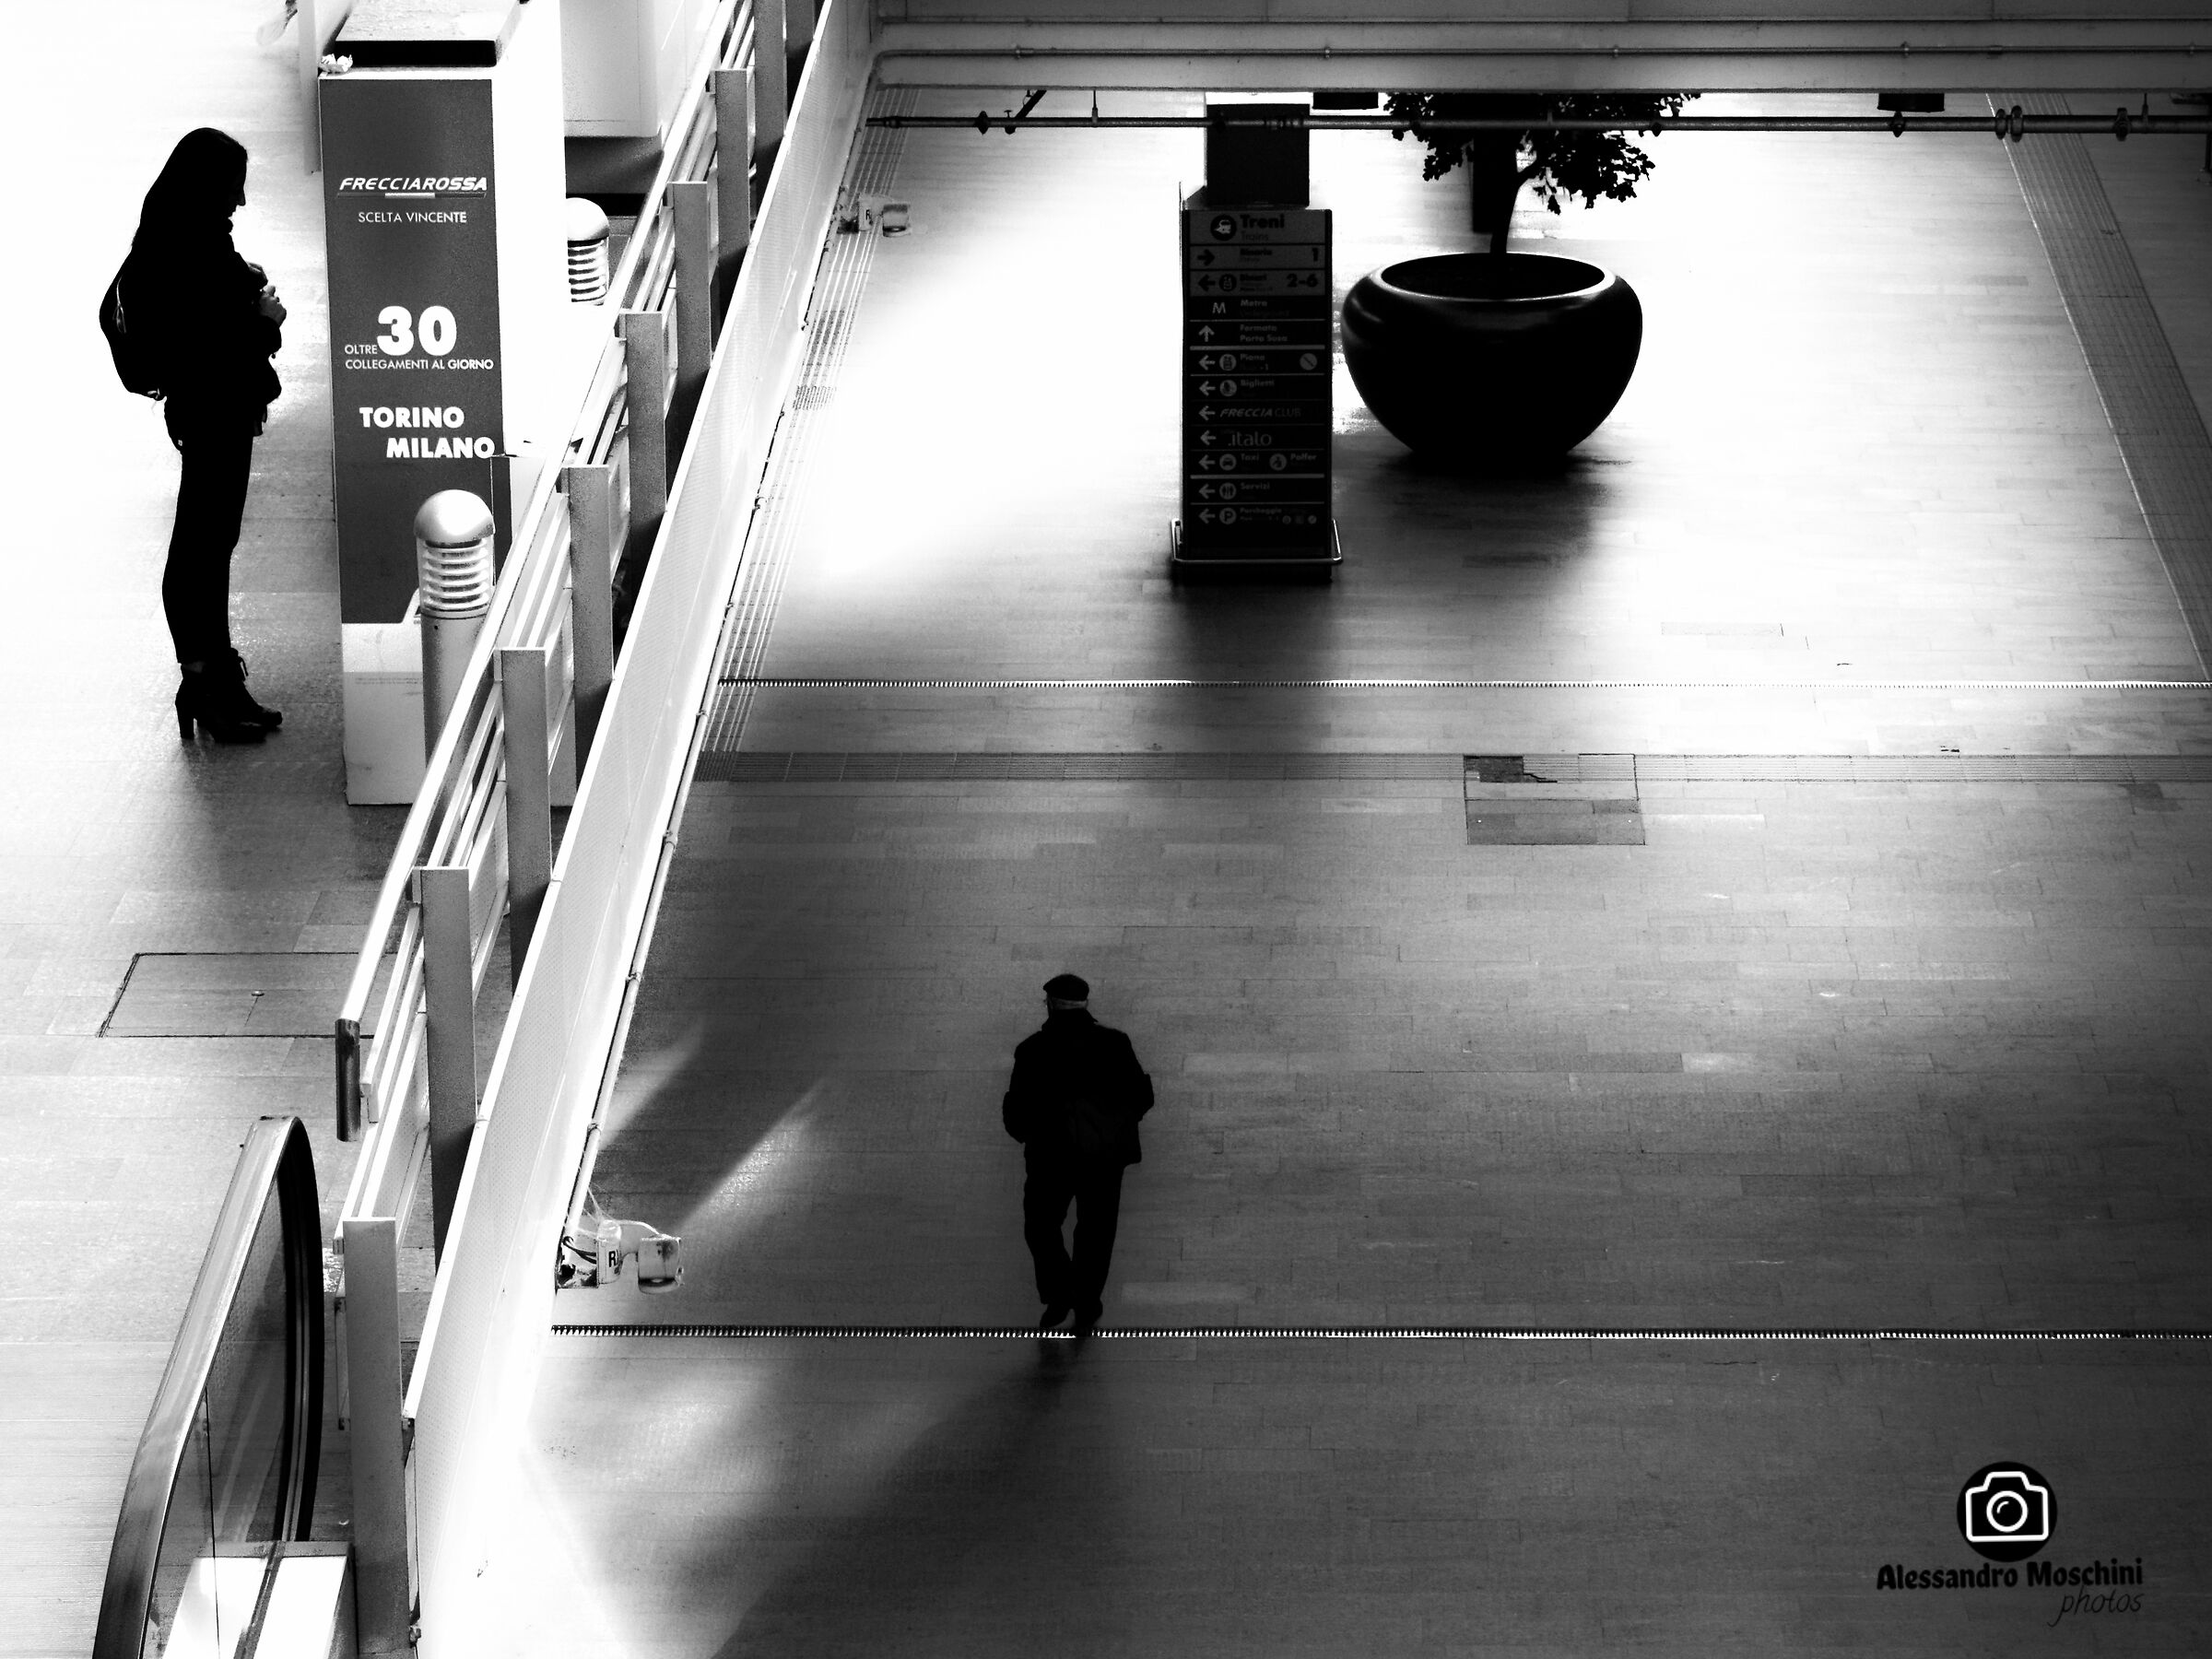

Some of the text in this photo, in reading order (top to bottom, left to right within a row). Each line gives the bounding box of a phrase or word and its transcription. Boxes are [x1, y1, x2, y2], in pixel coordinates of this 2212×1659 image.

[339, 176, 488, 192] FRECCIAROSSA
[358, 211, 467, 224] SCELTA VINCENTE
[1240, 213, 1286, 229] Treni
[1312, 247, 1319, 262] 1
[1287, 273, 1319, 288] 2-6
[1212, 299, 1268, 314] M Metro
[344, 305, 458, 356] OLTRE 30
[345, 359, 494, 371] COLLEGAMENTI AL GIORNO
[359, 406, 465, 429] TORINO
[386, 436, 496, 459] MILANO
[1241, 452, 1260, 461] Taxi
[1290, 452, 1318, 461] Polfer
